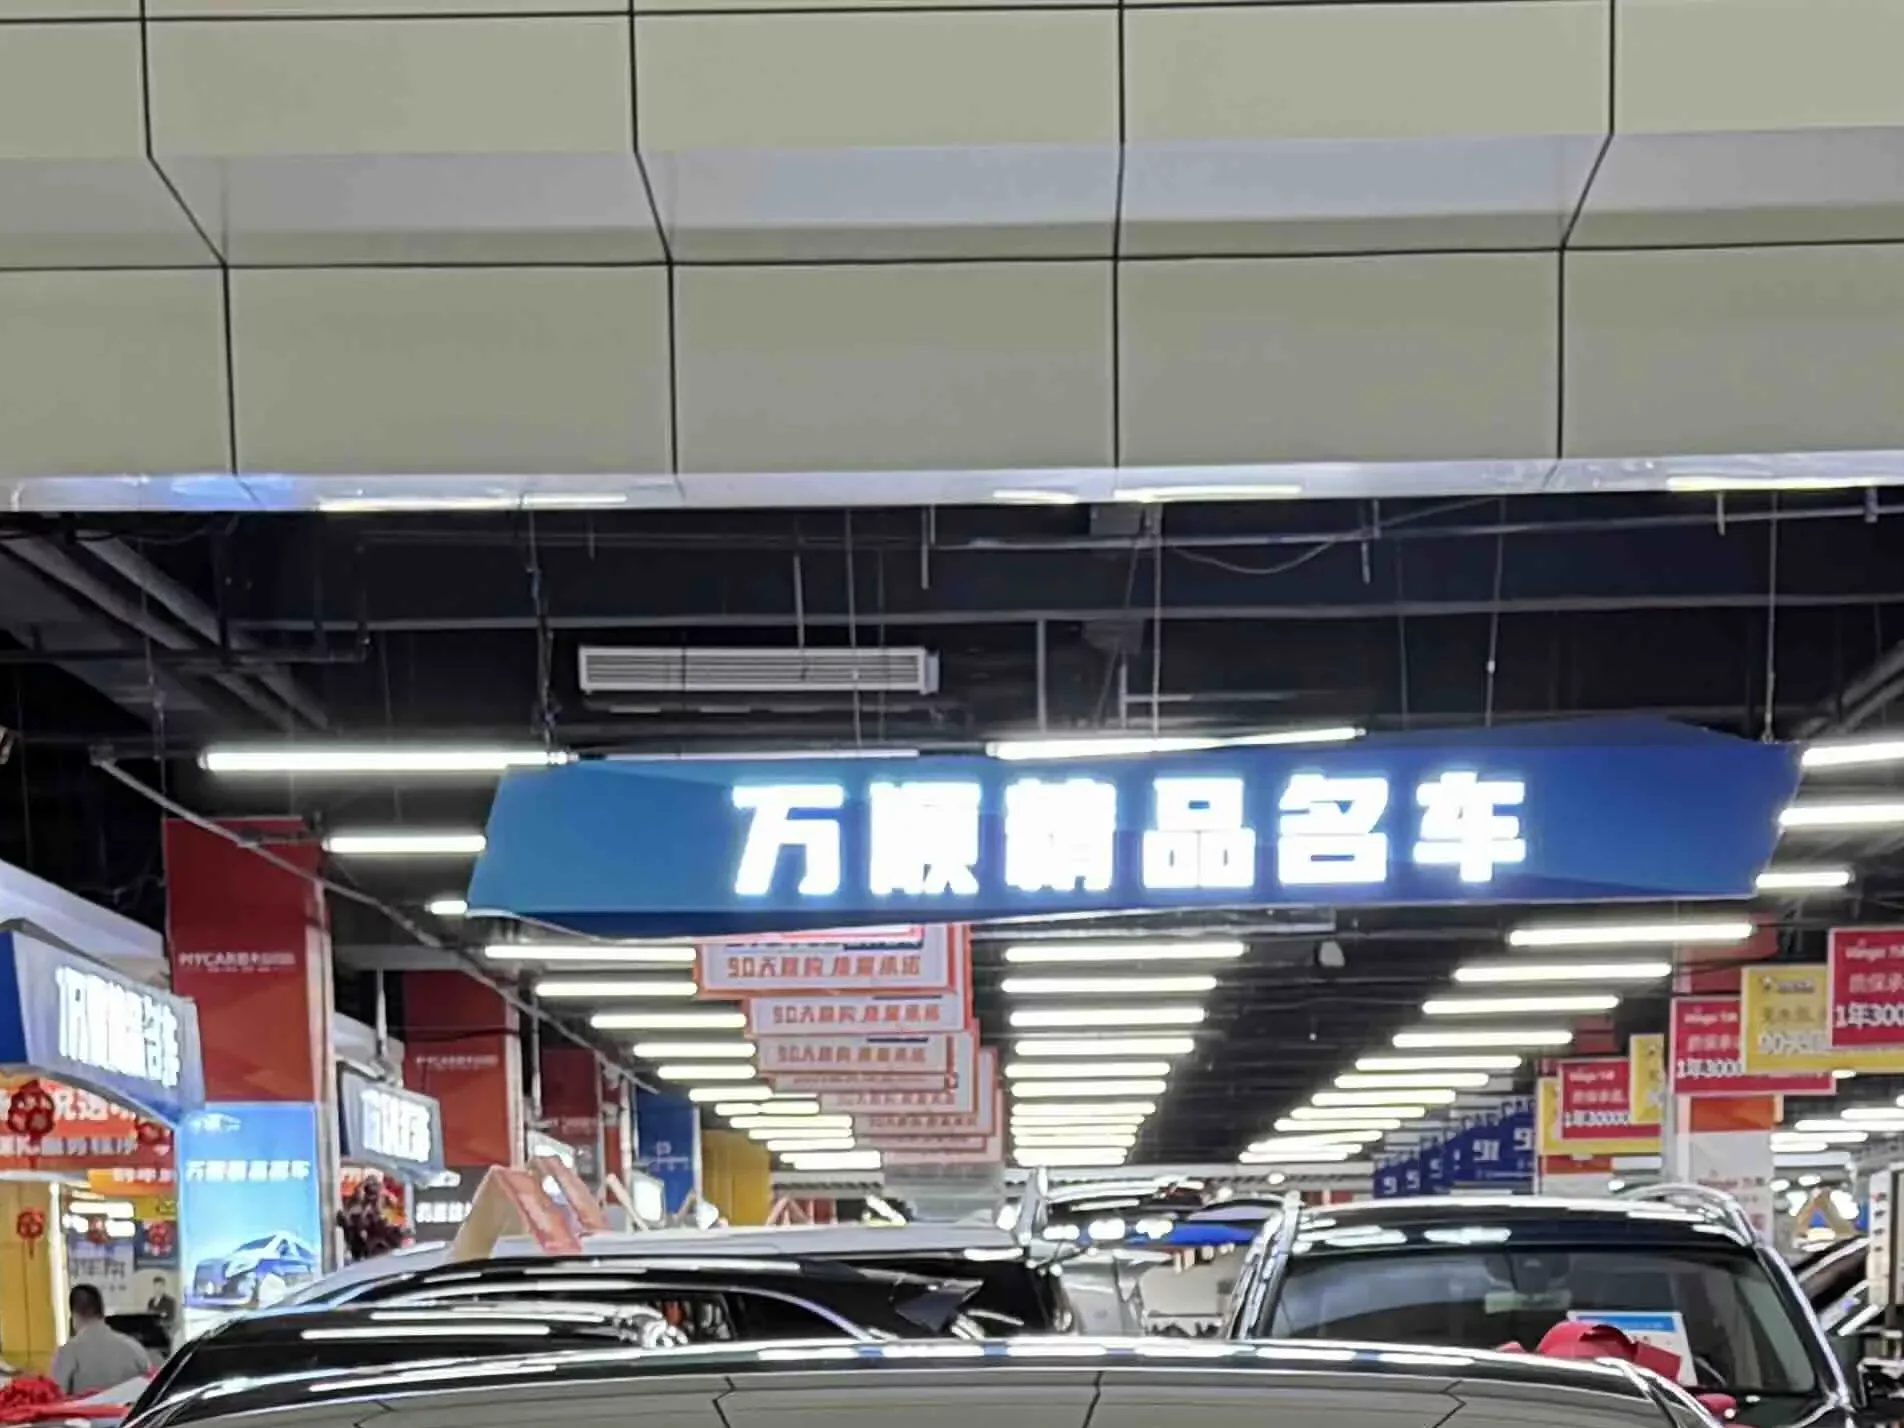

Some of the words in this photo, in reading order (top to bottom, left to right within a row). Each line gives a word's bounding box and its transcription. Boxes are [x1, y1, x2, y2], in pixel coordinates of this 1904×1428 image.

[732, 770, 1527, 895] 万顺精品名车
